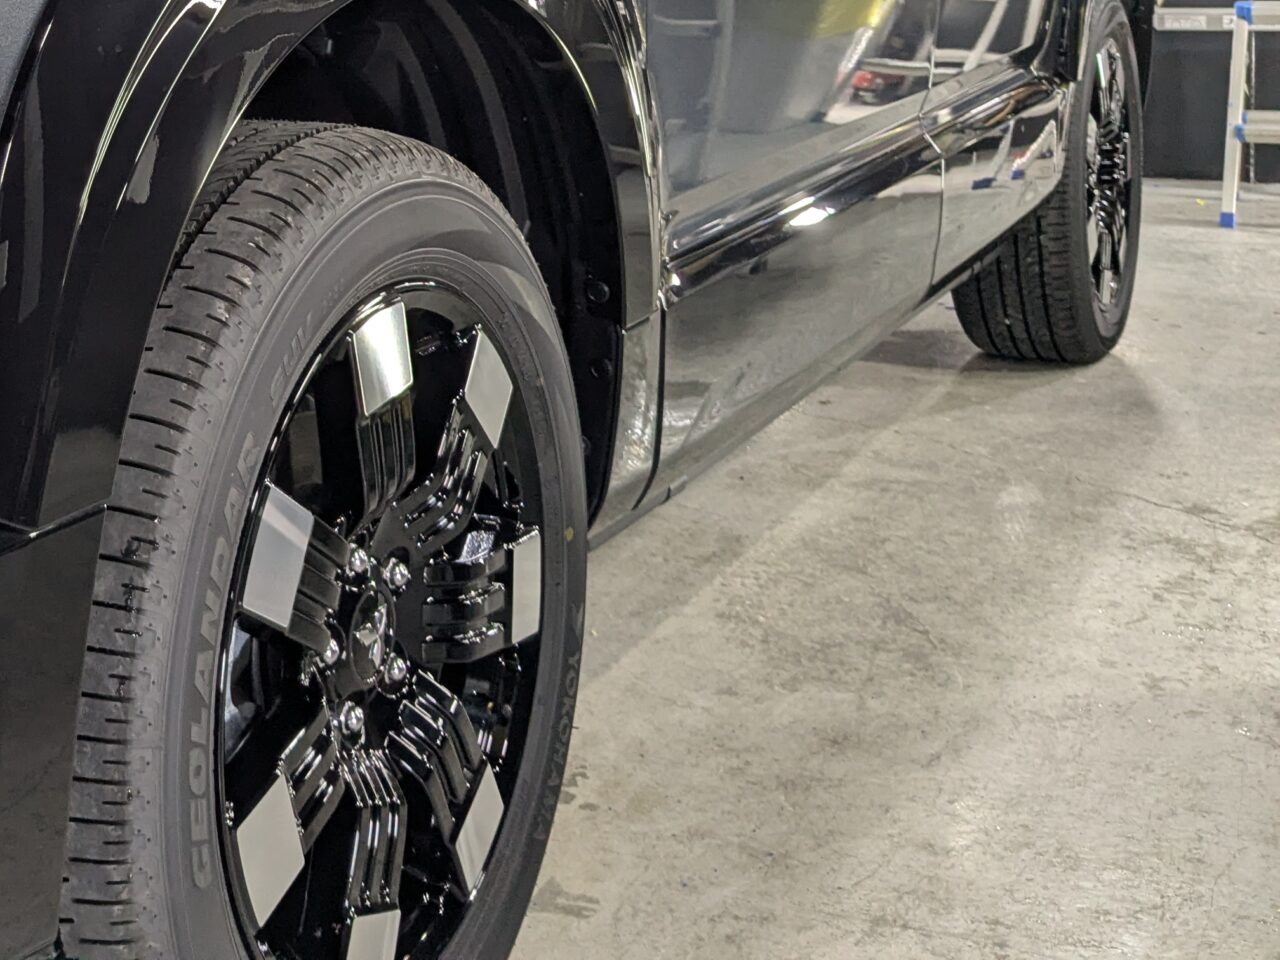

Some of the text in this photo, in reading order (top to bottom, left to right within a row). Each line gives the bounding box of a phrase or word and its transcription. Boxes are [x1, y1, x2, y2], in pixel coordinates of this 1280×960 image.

[270, 312, 312, 407] SUV
[189, 431, 261, 889] GEOLANDAR
[533, 651, 581, 839] YOKOHAMA
